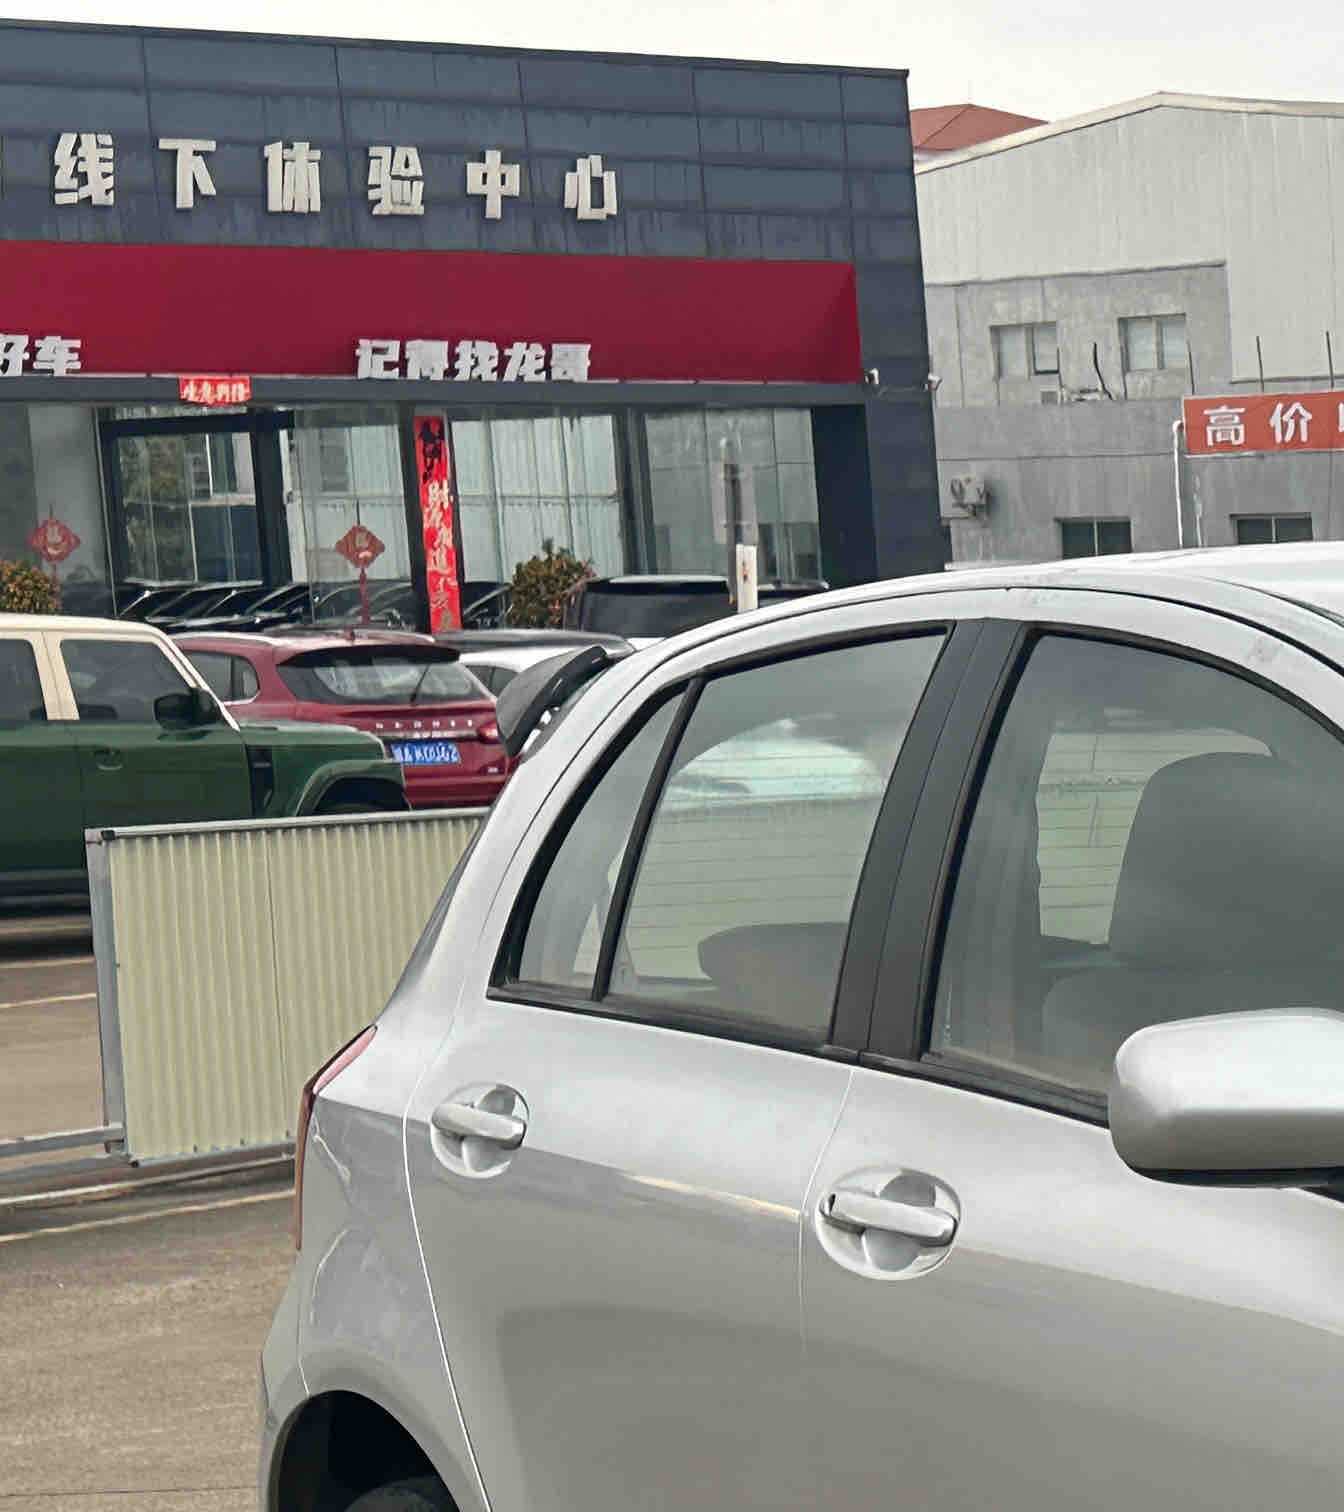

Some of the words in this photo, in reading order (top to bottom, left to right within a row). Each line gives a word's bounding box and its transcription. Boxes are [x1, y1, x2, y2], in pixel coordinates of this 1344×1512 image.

[54, 132, 618, 221] 线下体验中心
[356, 339, 592, 384] 记得找龙哥
